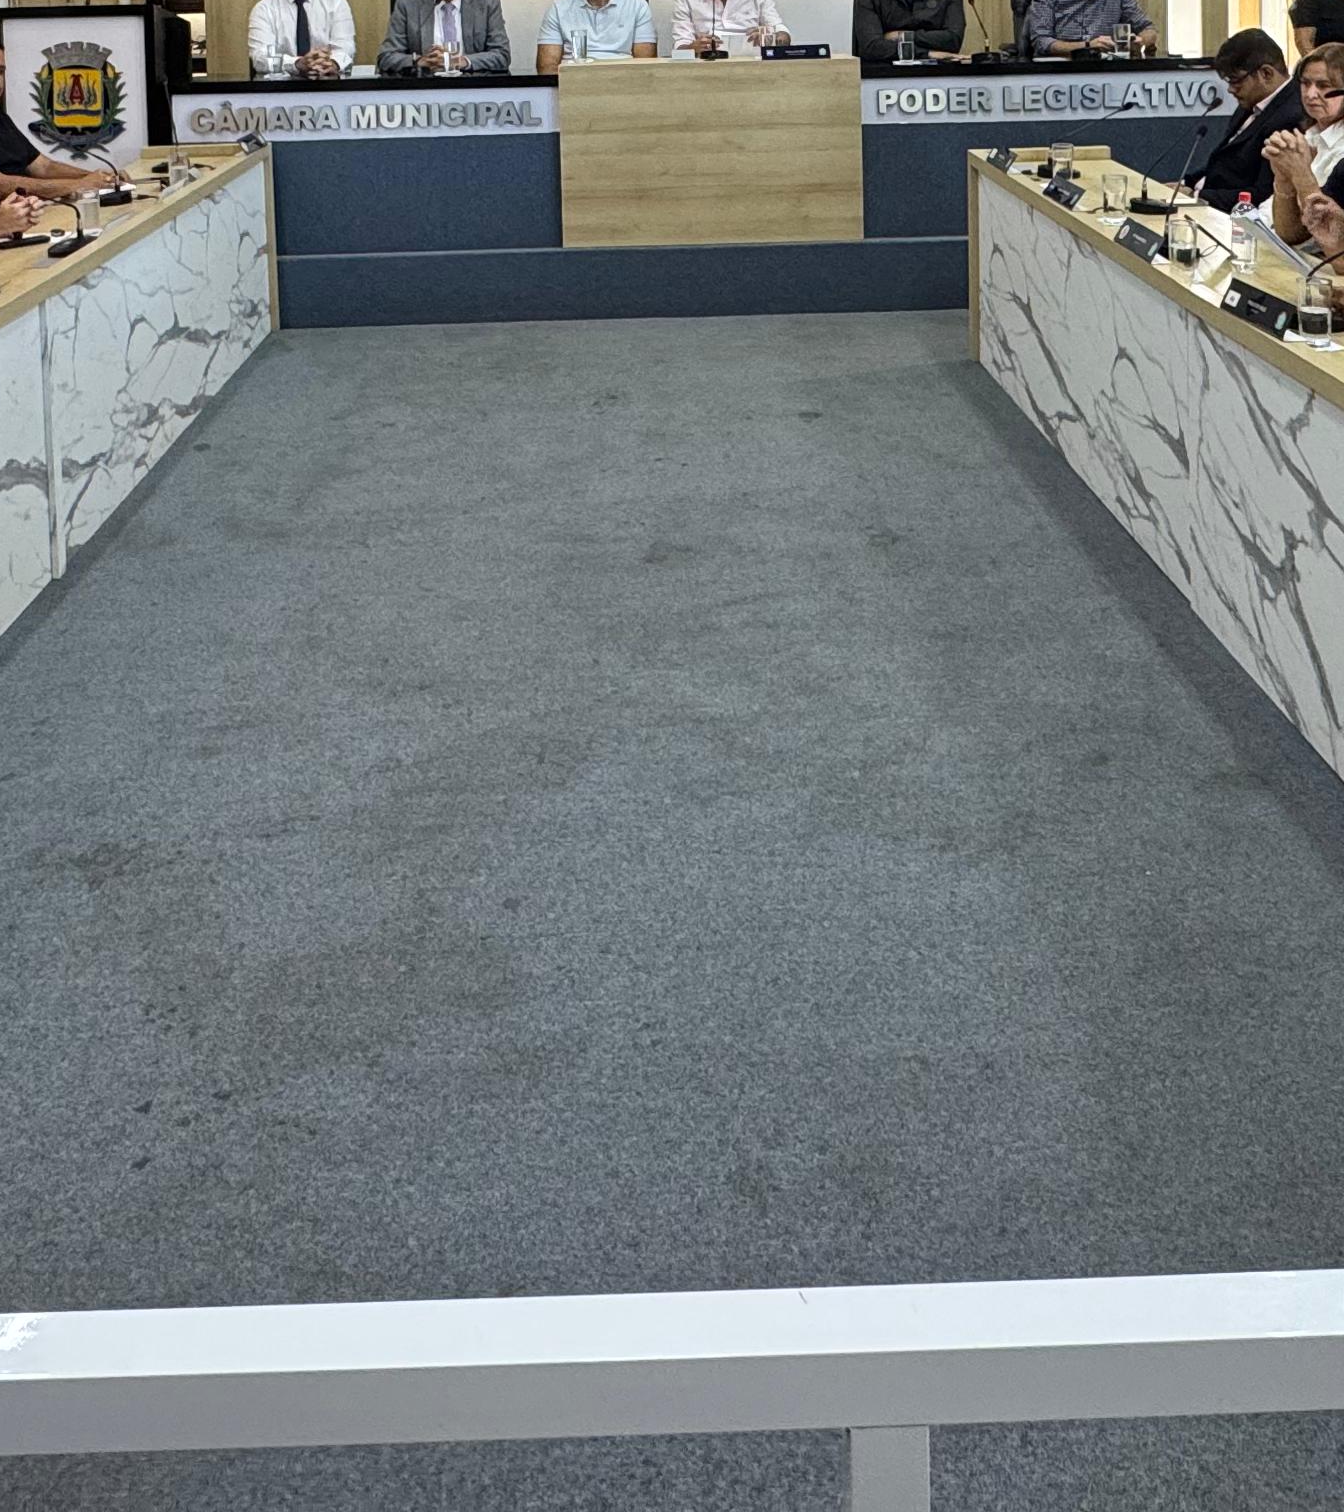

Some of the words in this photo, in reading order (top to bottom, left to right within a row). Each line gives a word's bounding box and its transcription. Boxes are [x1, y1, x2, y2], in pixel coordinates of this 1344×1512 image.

[877, 87, 992, 116] PODER
[1002, 80, 1222, 113] LEGISLATIVO
[190, 100, 340, 135] CÂMARA
[350, 100, 542, 131] MUNICIPAL
